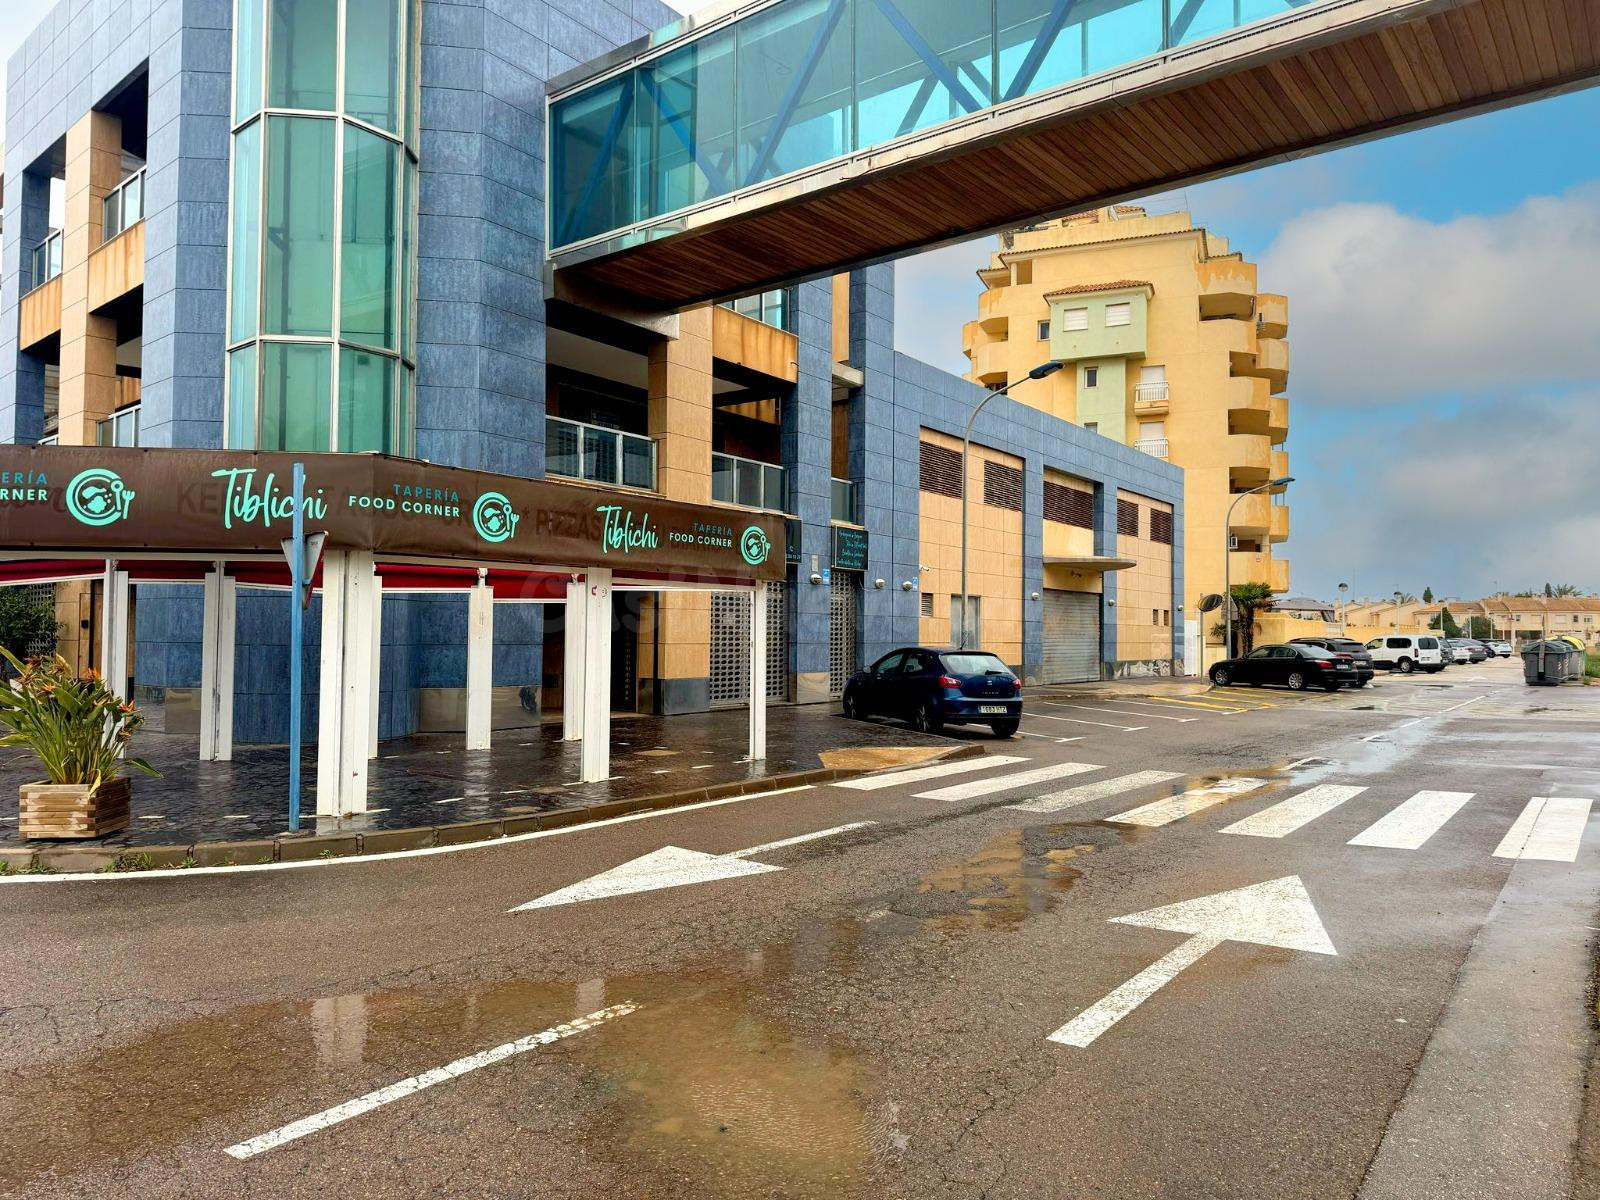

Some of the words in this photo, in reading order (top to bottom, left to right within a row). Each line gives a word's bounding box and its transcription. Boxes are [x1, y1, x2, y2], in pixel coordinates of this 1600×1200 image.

[393, 483, 459, 502] TAPERÍA
[348, 495, 396, 510] FOOD
[402, 501, 460, 518] CORNER
[596, 505, 659, 554] Tiblichi
[669, 532, 694, 543] FOOD
[697, 536, 732, 548] CORNER
